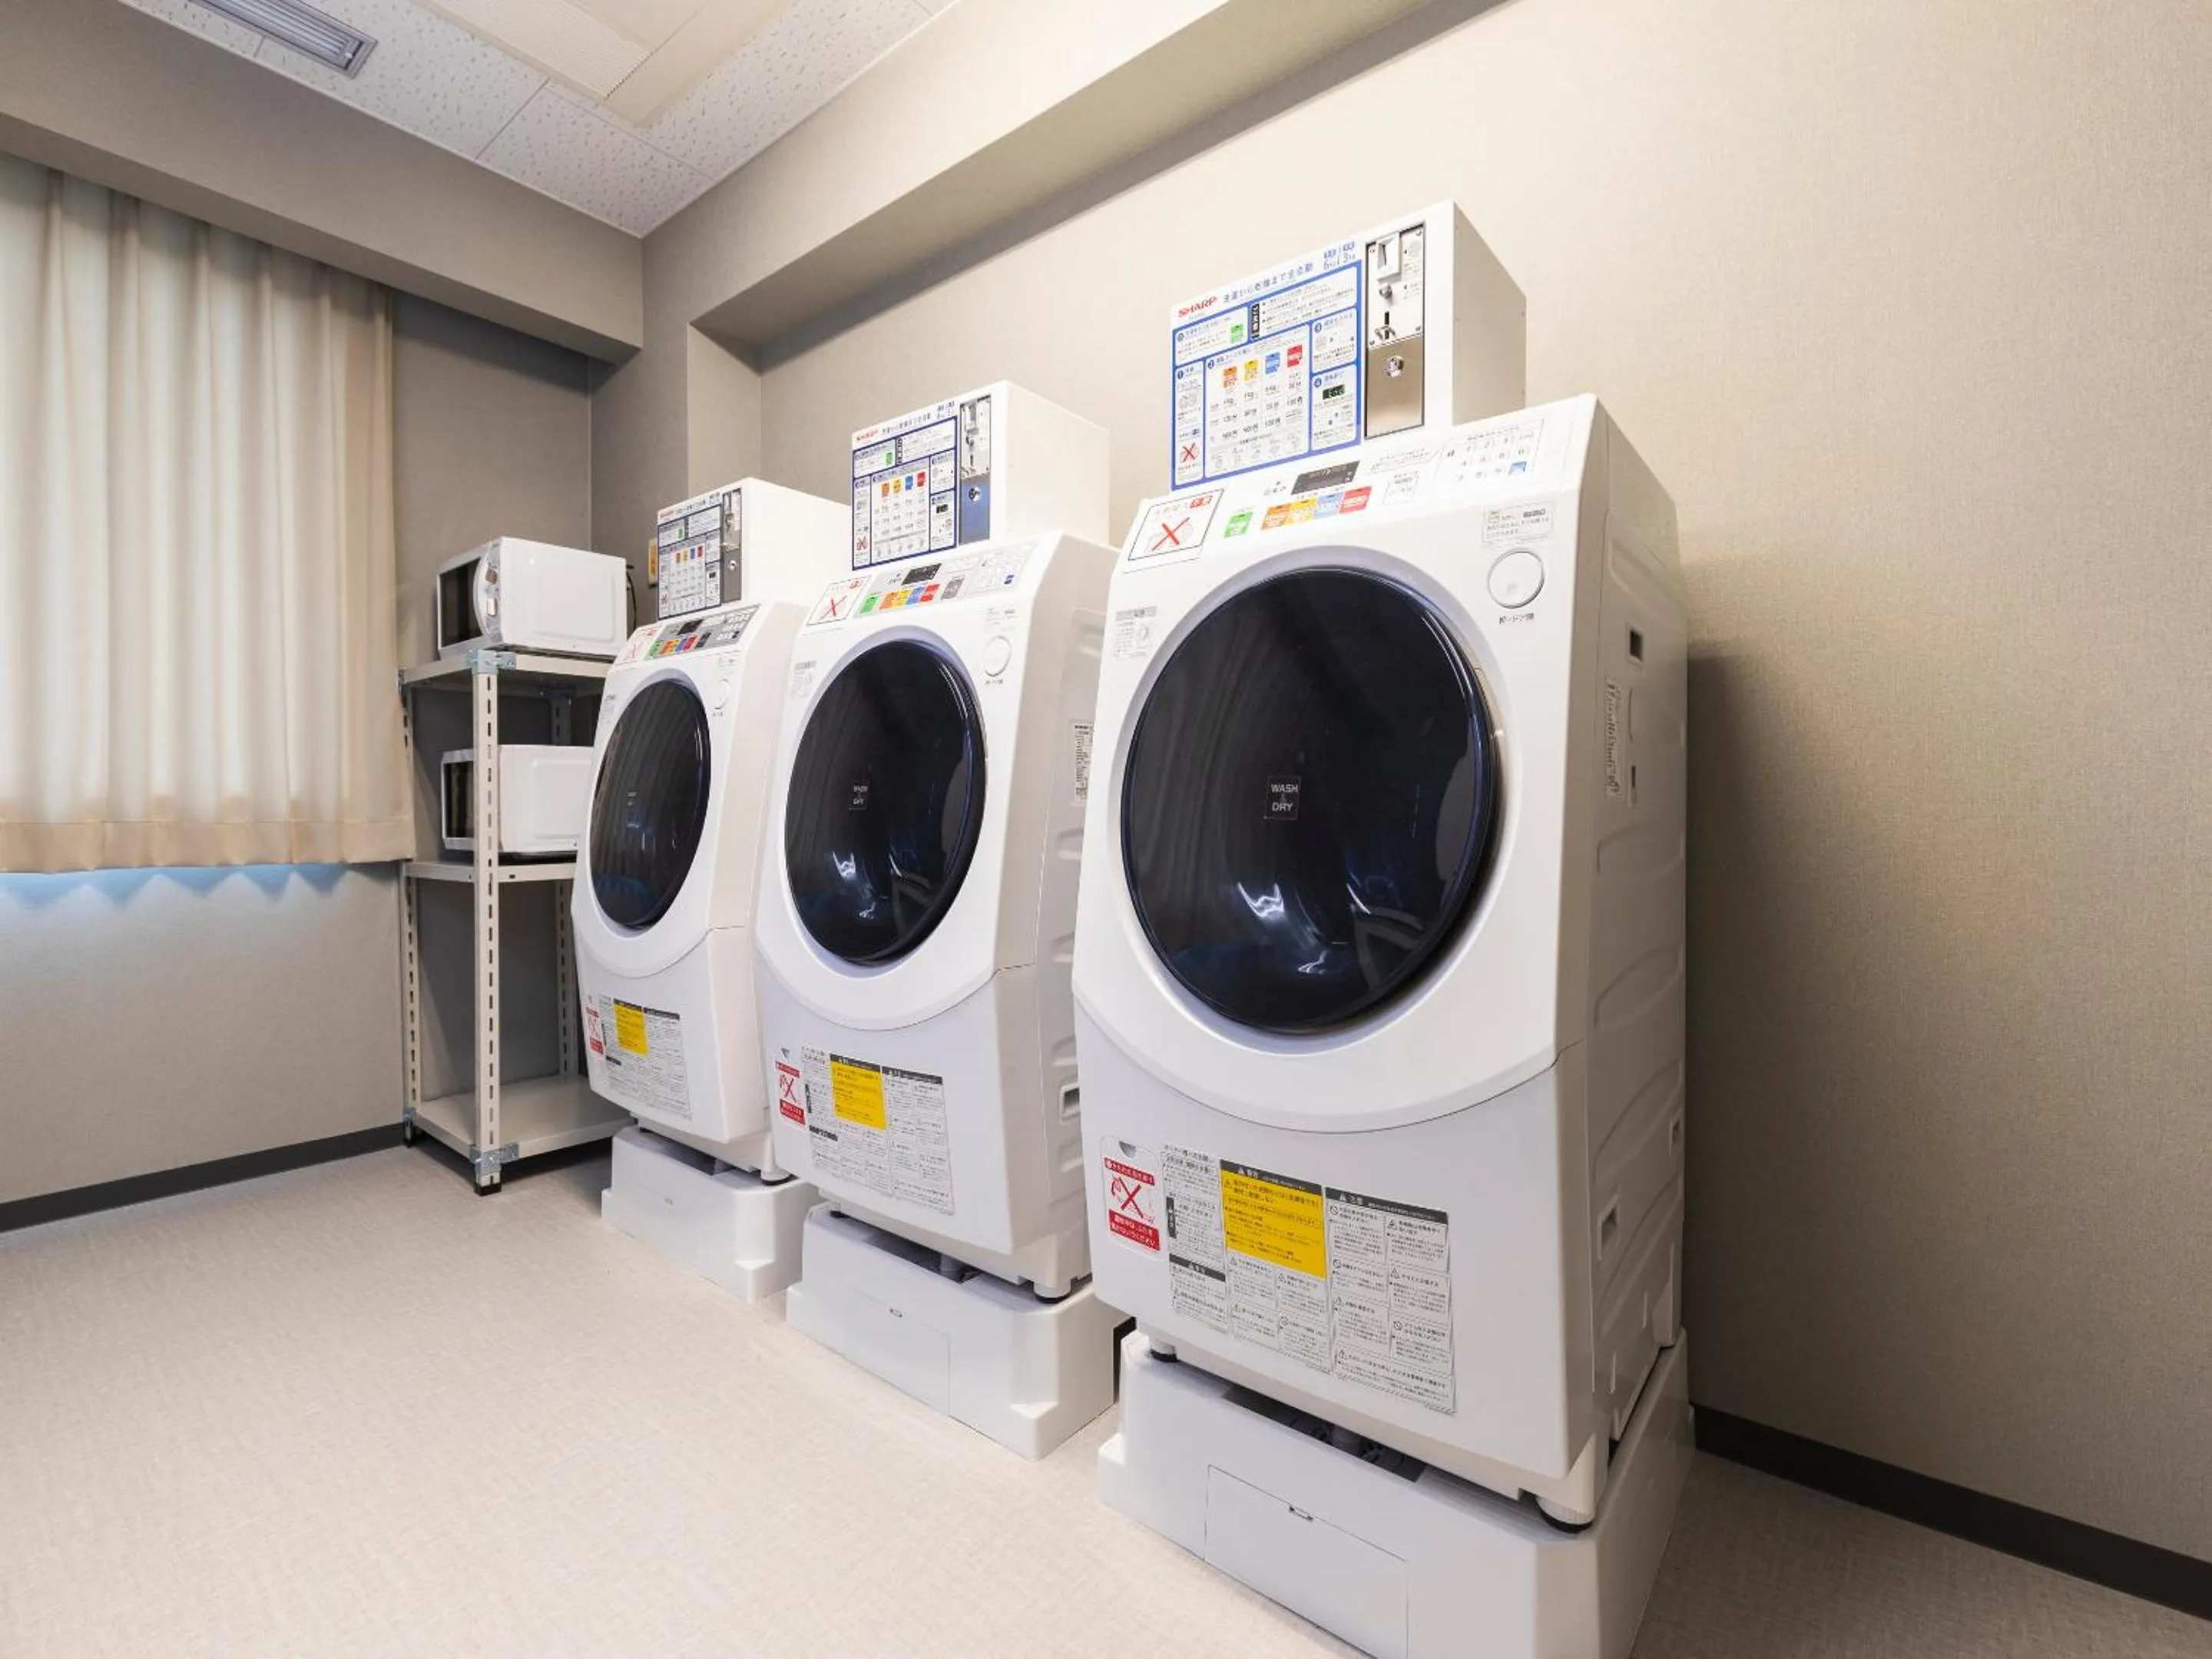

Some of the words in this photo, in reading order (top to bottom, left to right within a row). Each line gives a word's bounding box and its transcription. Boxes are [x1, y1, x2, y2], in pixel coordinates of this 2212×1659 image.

[1178, 296, 1217, 318] SHARP
[1270, 783, 1298, 793] WASH
[1272, 802, 1293, 812] DRY
